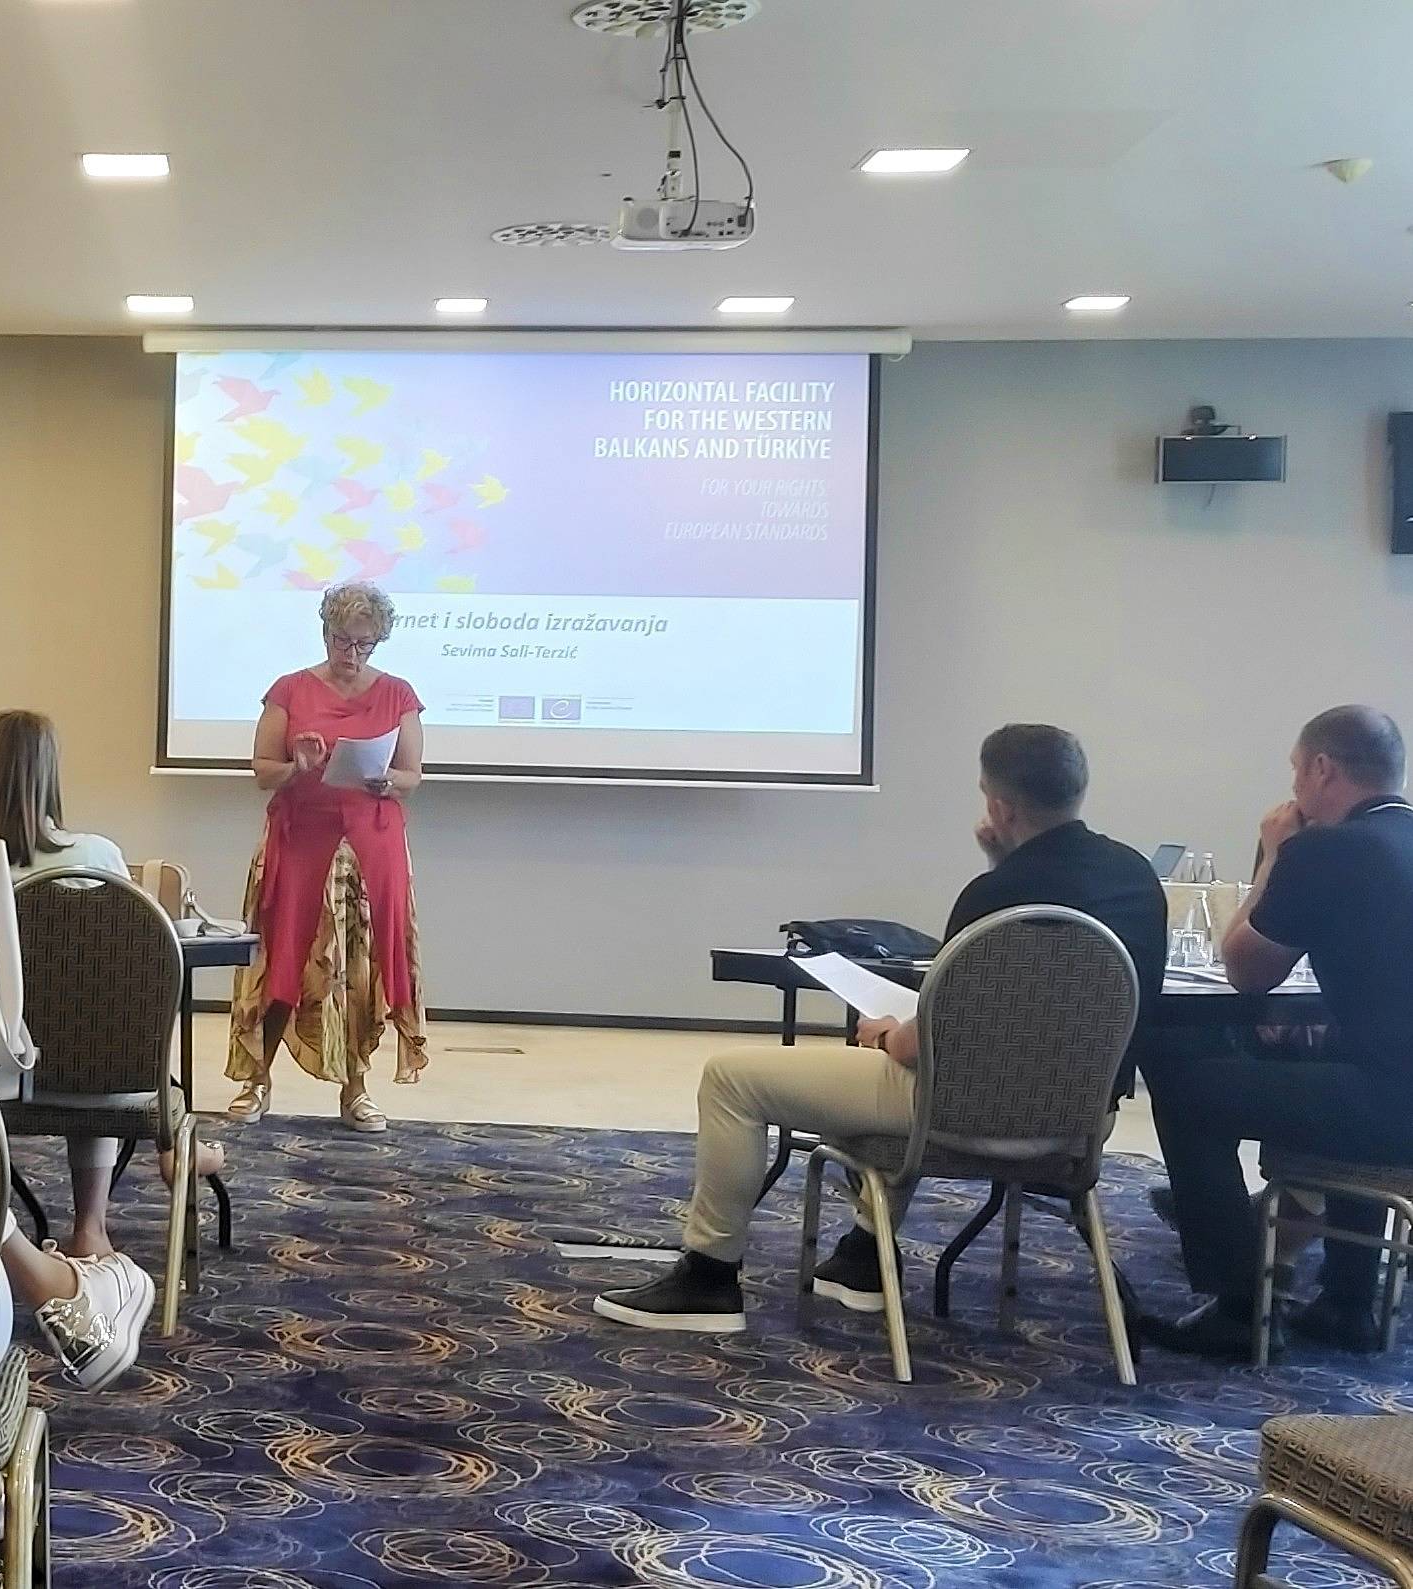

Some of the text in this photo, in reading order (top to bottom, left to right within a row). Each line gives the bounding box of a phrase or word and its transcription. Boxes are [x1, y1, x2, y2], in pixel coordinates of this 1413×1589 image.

[609, 381, 835, 403] HORIZONTAL FACILITY
[644, 409, 832, 431] FOR THE WESTERN
[594, 437, 689, 458] BALKANS
[695, 438, 739, 458] AND
[700, 478, 827, 497] FOR YOUR RIGHTS
[761, 501, 829, 518] TOWARDS
[665, 521, 828, 541] EUROPEAN STANDARDS
[444, 611, 451, 628] i
[455, 612, 539, 631] sloboda
[545, 613, 668, 636] izražavanja
[441, 644, 497, 657] Sevima
